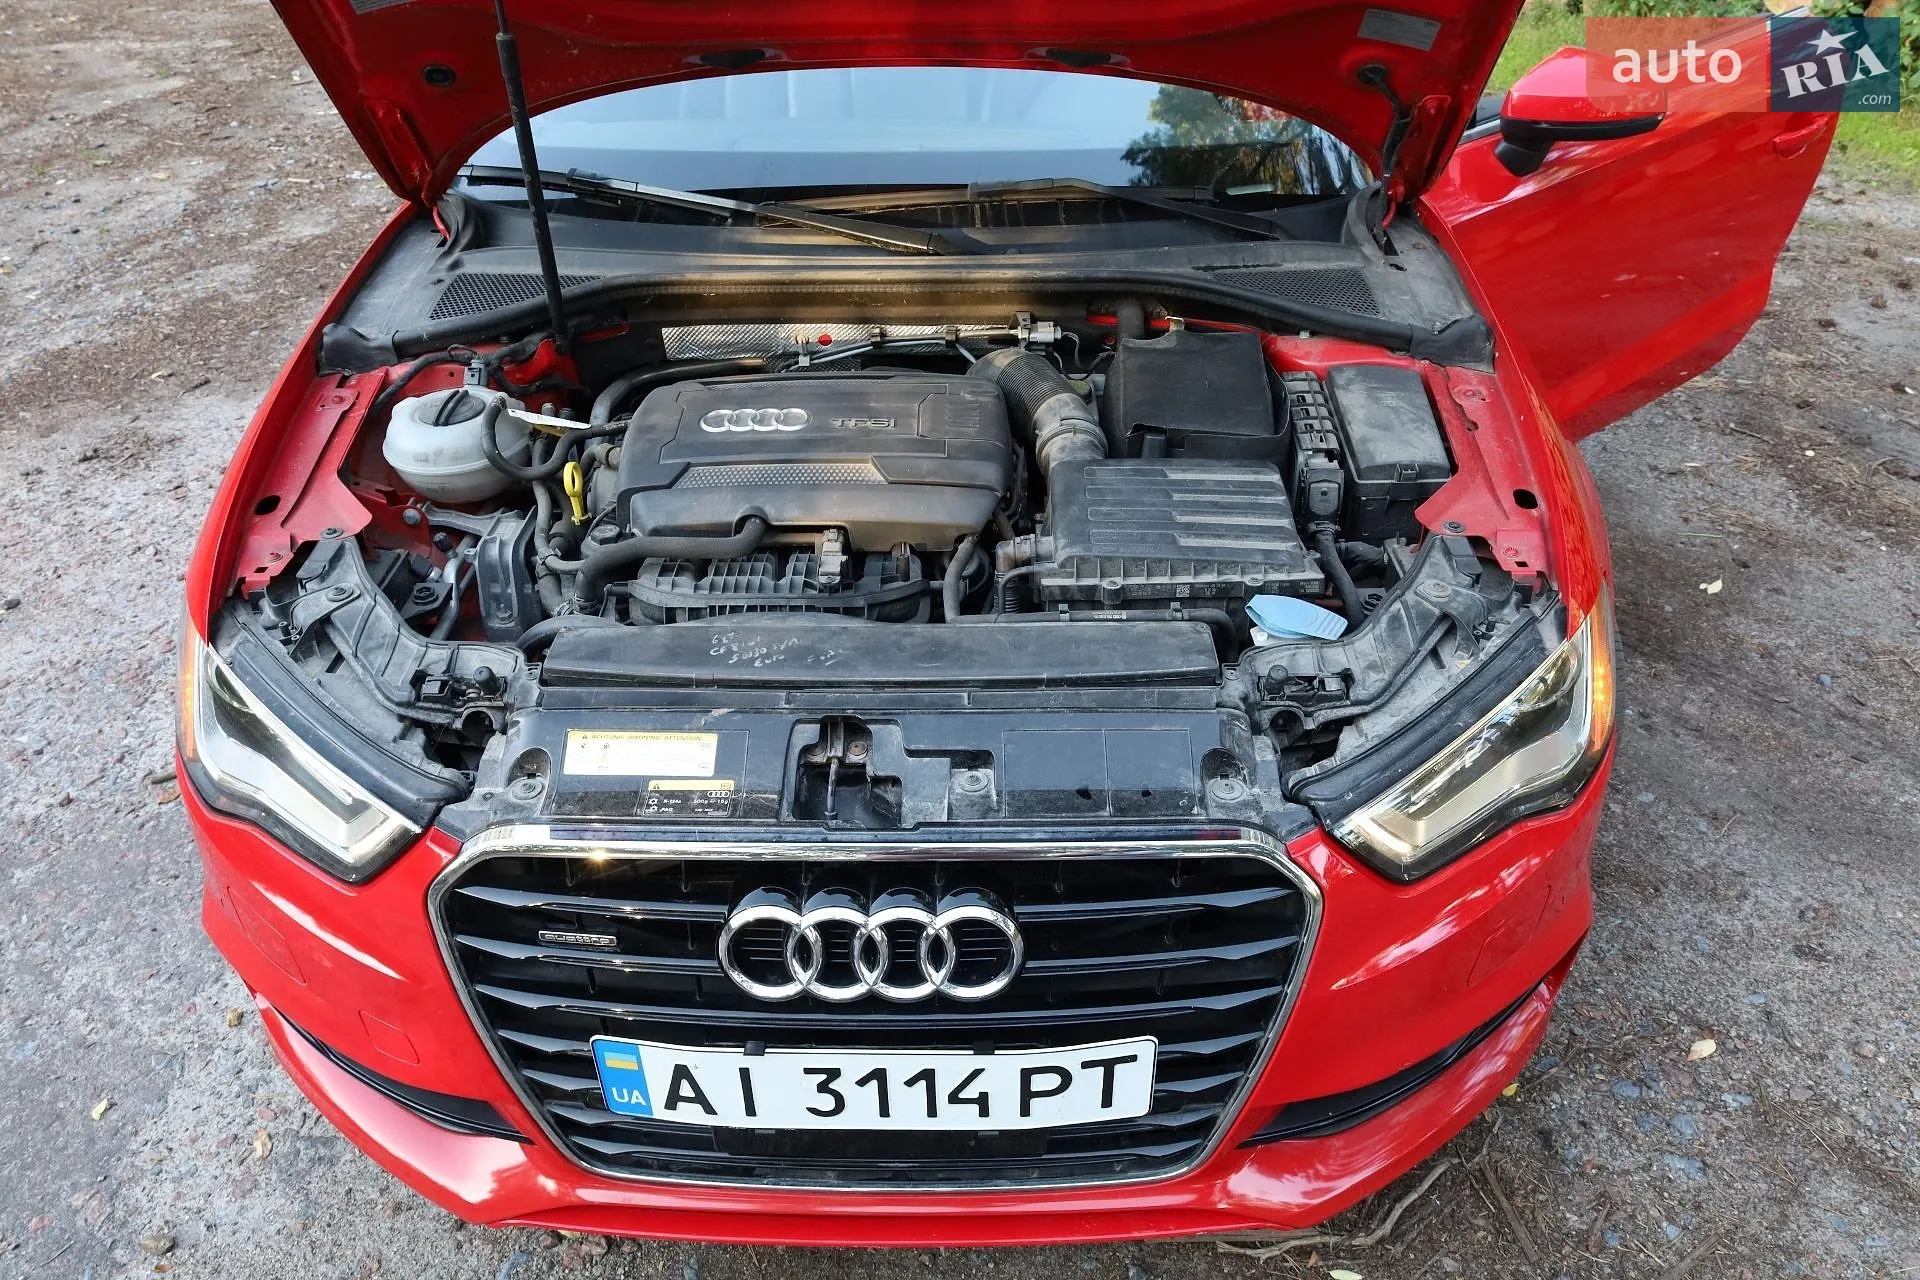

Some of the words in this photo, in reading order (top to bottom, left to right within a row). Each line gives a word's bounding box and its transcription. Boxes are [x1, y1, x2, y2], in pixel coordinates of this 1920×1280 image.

[831, 417, 897, 430] TFSI
[611, 1086, 647, 1106] UA
[803, 1067, 989, 1118] 3114
[1019, 1054, 1139, 1118] PT
